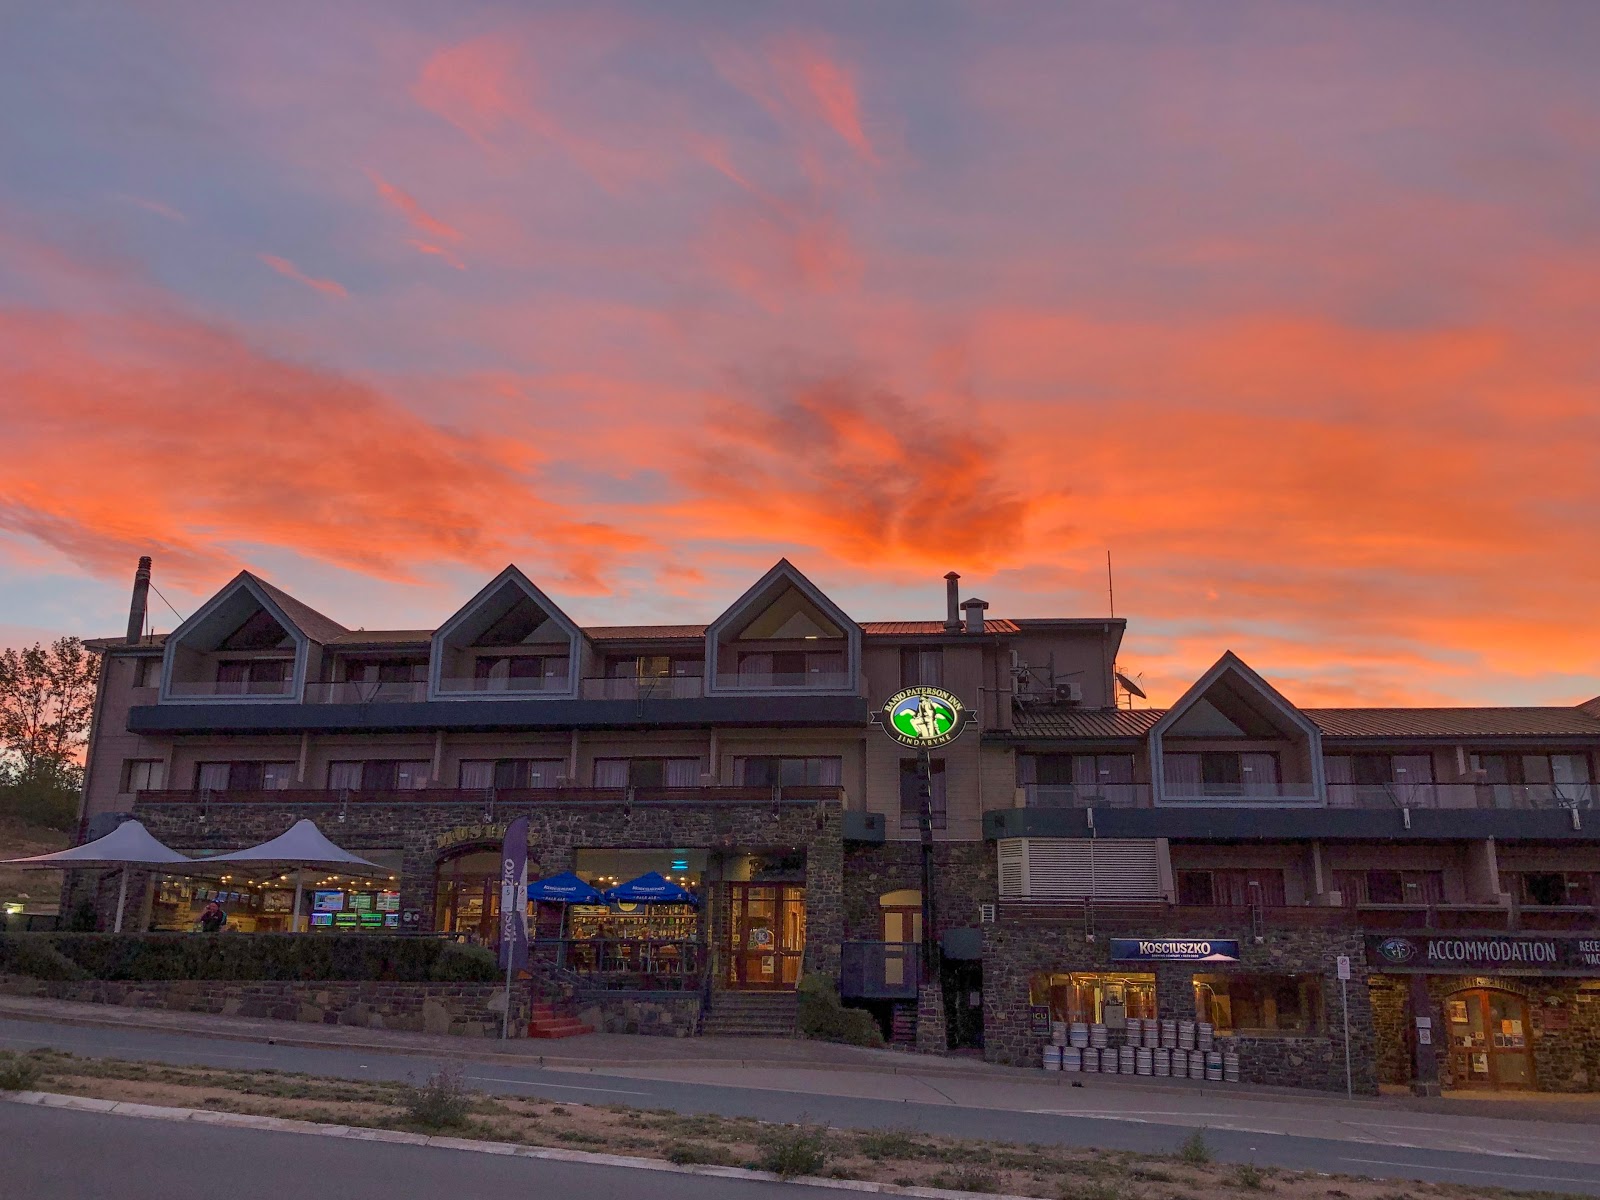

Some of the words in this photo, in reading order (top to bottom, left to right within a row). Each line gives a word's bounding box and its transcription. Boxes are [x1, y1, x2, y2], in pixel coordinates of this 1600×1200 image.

[884, 692, 906, 713] BANJO
[905, 687, 949, 701] PATERSON
[947, 694, 963, 711] INN
[896, 733, 951, 746] JINDABYNE
[1139, 941, 1211, 955] KOSCIUSZKO
[1427, 940, 1557, 962] ACCOMMODATION
[1579, 940, 1600, 952] RECE
